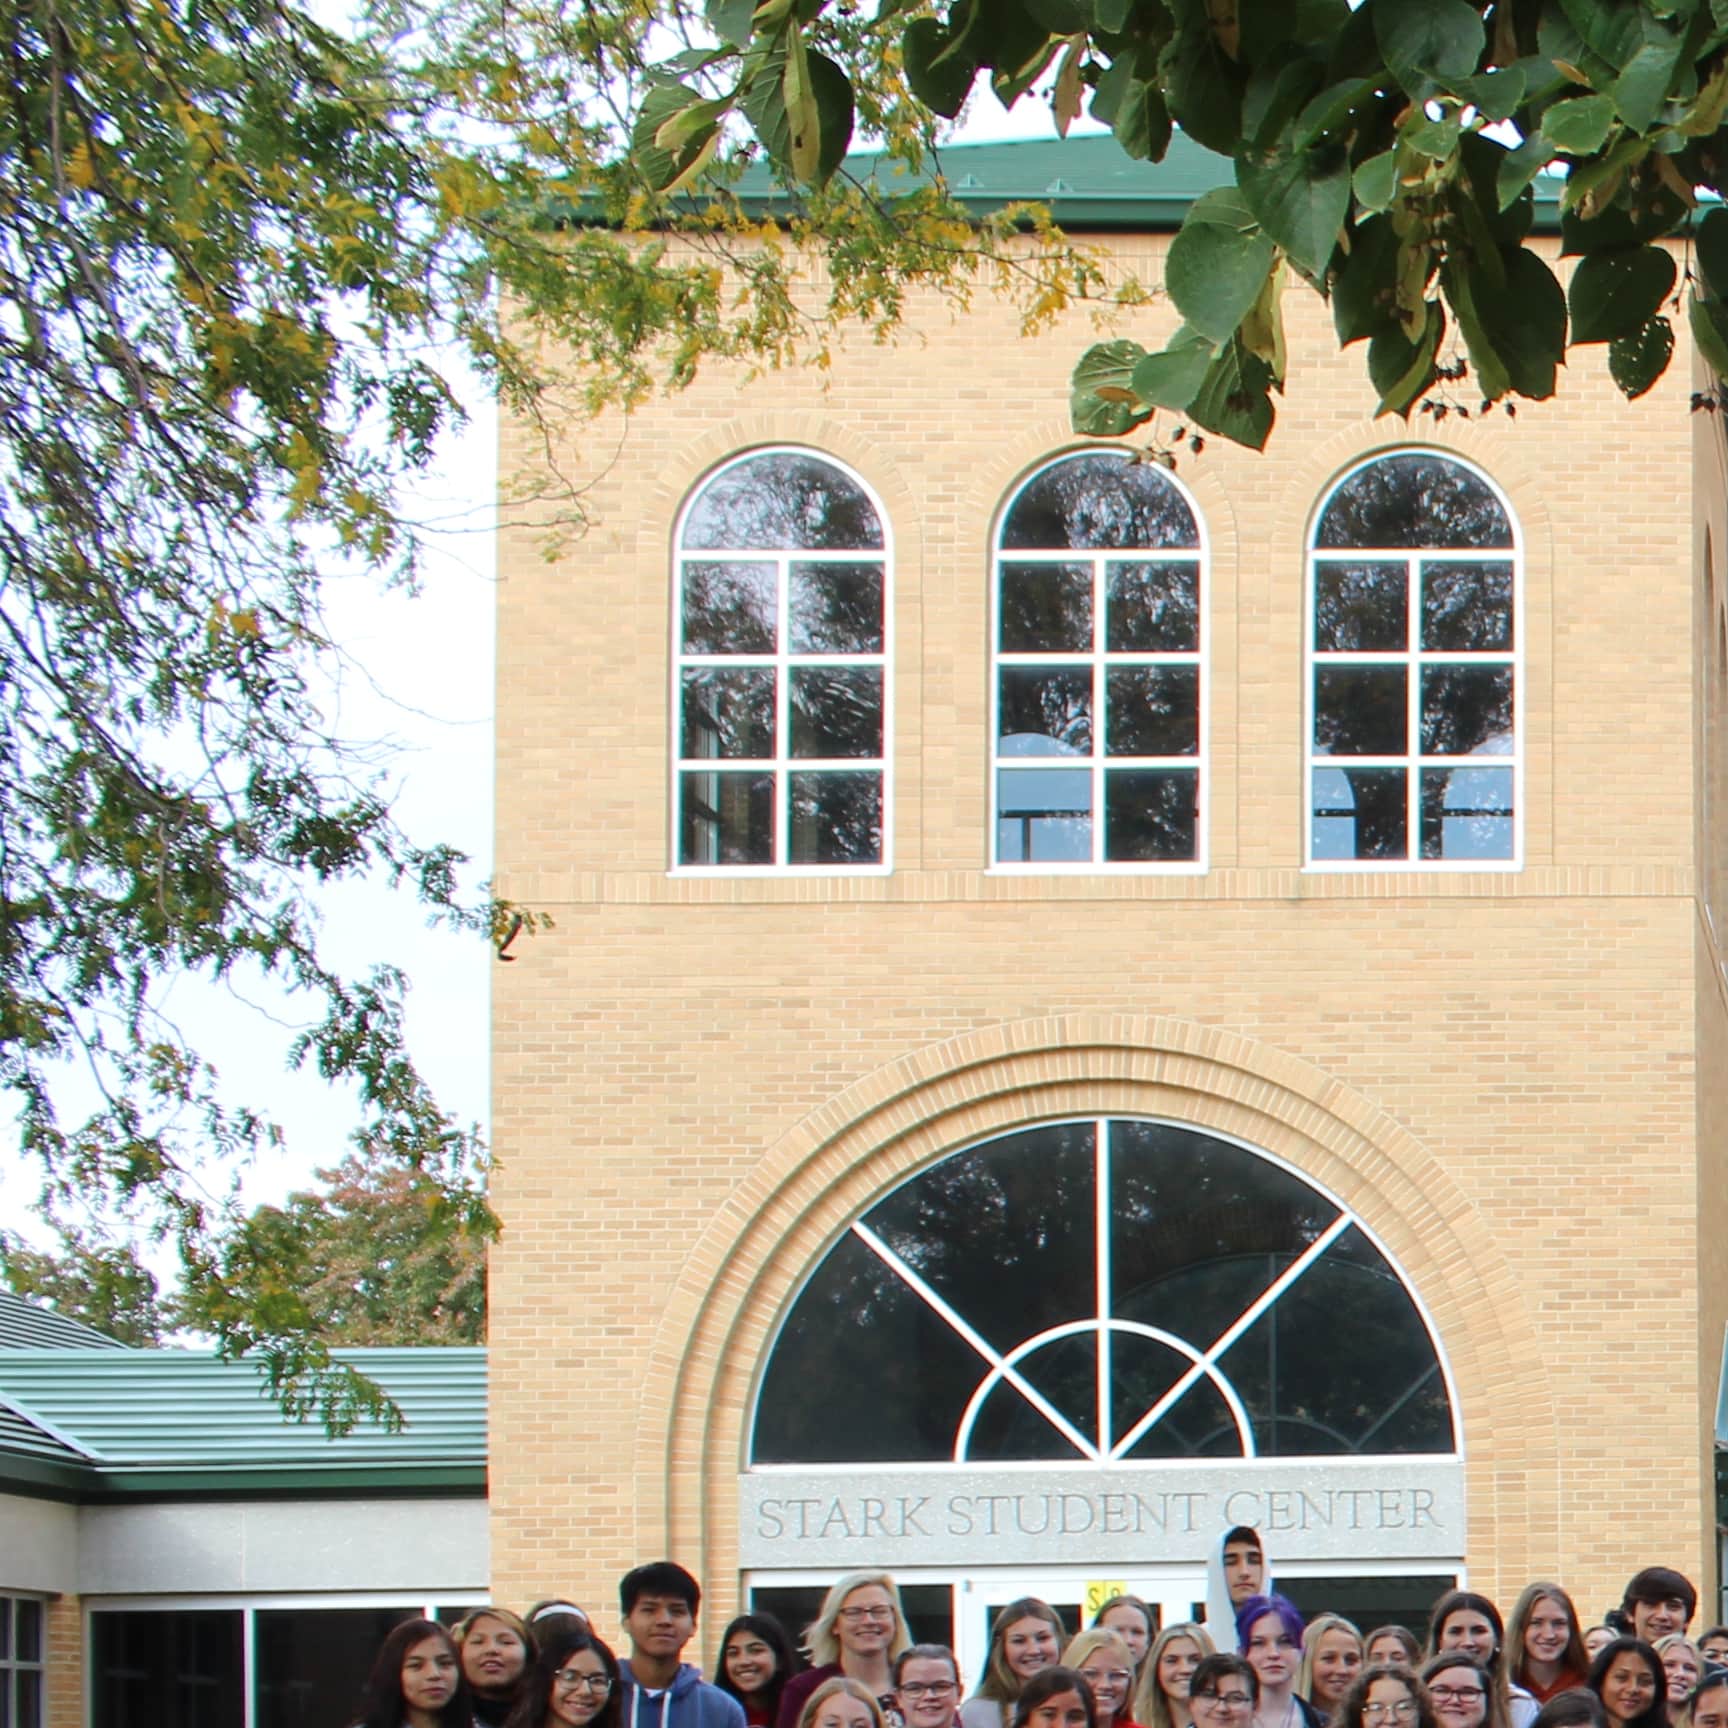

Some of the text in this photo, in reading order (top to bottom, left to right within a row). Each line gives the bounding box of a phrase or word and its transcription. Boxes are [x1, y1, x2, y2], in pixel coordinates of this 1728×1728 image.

[757, 1488, 1445, 1539] STARK STUDENT CENTER
